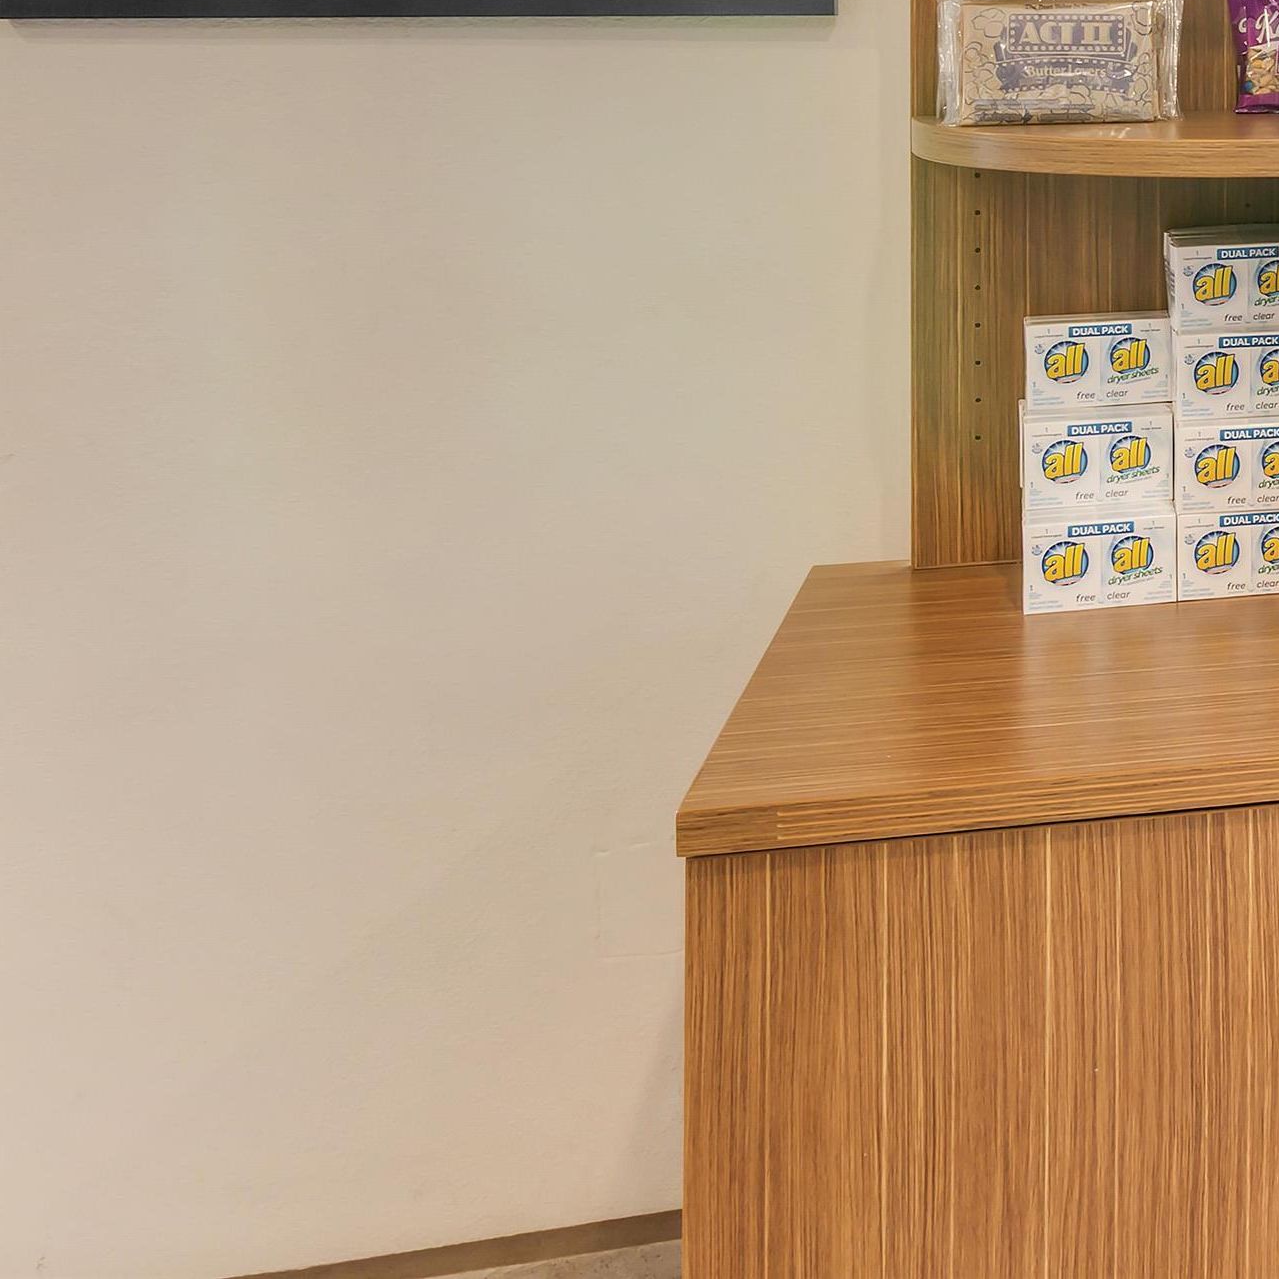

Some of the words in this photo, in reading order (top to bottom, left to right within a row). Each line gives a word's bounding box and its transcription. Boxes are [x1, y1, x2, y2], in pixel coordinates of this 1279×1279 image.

[1018, 21, 1077, 45] ACT
[1080, 22, 1113, 45] II
[1025, 64, 1067, 78] Butter
[1067, 64, 1107, 78] Lovers
[1221, 250, 1247, 259] DUAL
[1249, 248, 1276, 257] PACK
[1194, 265, 1233, 302] all
[1254, 296, 1279, 306] dryer
[1224, 313, 1243, 322] free
[1253, 312, 1275, 320] clear
[1072, 327, 1100, 336] DUAL
[1101, 325, 1129, 335] PACK
[1223, 337, 1250, 347] DUAL
[1252, 335, 1279, 346] PACK
[1046, 342, 1085, 379] all
[1112, 338, 1147, 372] all
[1107, 373, 1131, 385] dryer
[1131, 367, 1159, 380] sheets
[1196, 354, 1235, 390] all
[1076, 391, 1096, 400] free
[1106, 389, 1129, 398] clear
[1226, 402, 1245, 412] free
[1255, 401, 1278, 410] clear
[1071, 425, 1099, 435] DUAL
[1101, 423, 1129, 433] PACK
[1224, 430, 1251, 440] DUAL
[1112, 437, 1147, 473] all
[1043, 442, 1083, 482] all
[1196, 446, 1236, 484] all
[1075, 491, 1094, 500] free
[1105, 488, 1128, 498] clear
[1227, 496, 1246, 505] free
[1256, 494, 1279, 504] clear
[1223, 515, 1251, 526] DUAL
[1252, 513, 1279, 523] PACK
[1071, 525, 1101, 535] DUAL
[1102, 523, 1131, 533] PACK
[1113, 537, 1150, 573] all
[1196, 531, 1236, 570] all
[1043, 543, 1085, 583] all
[1227, 582, 1246, 591] free
[1256, 580, 1279, 589] clear
[1076, 593, 1096, 602] free
[1106, 590, 1130, 600] clear
